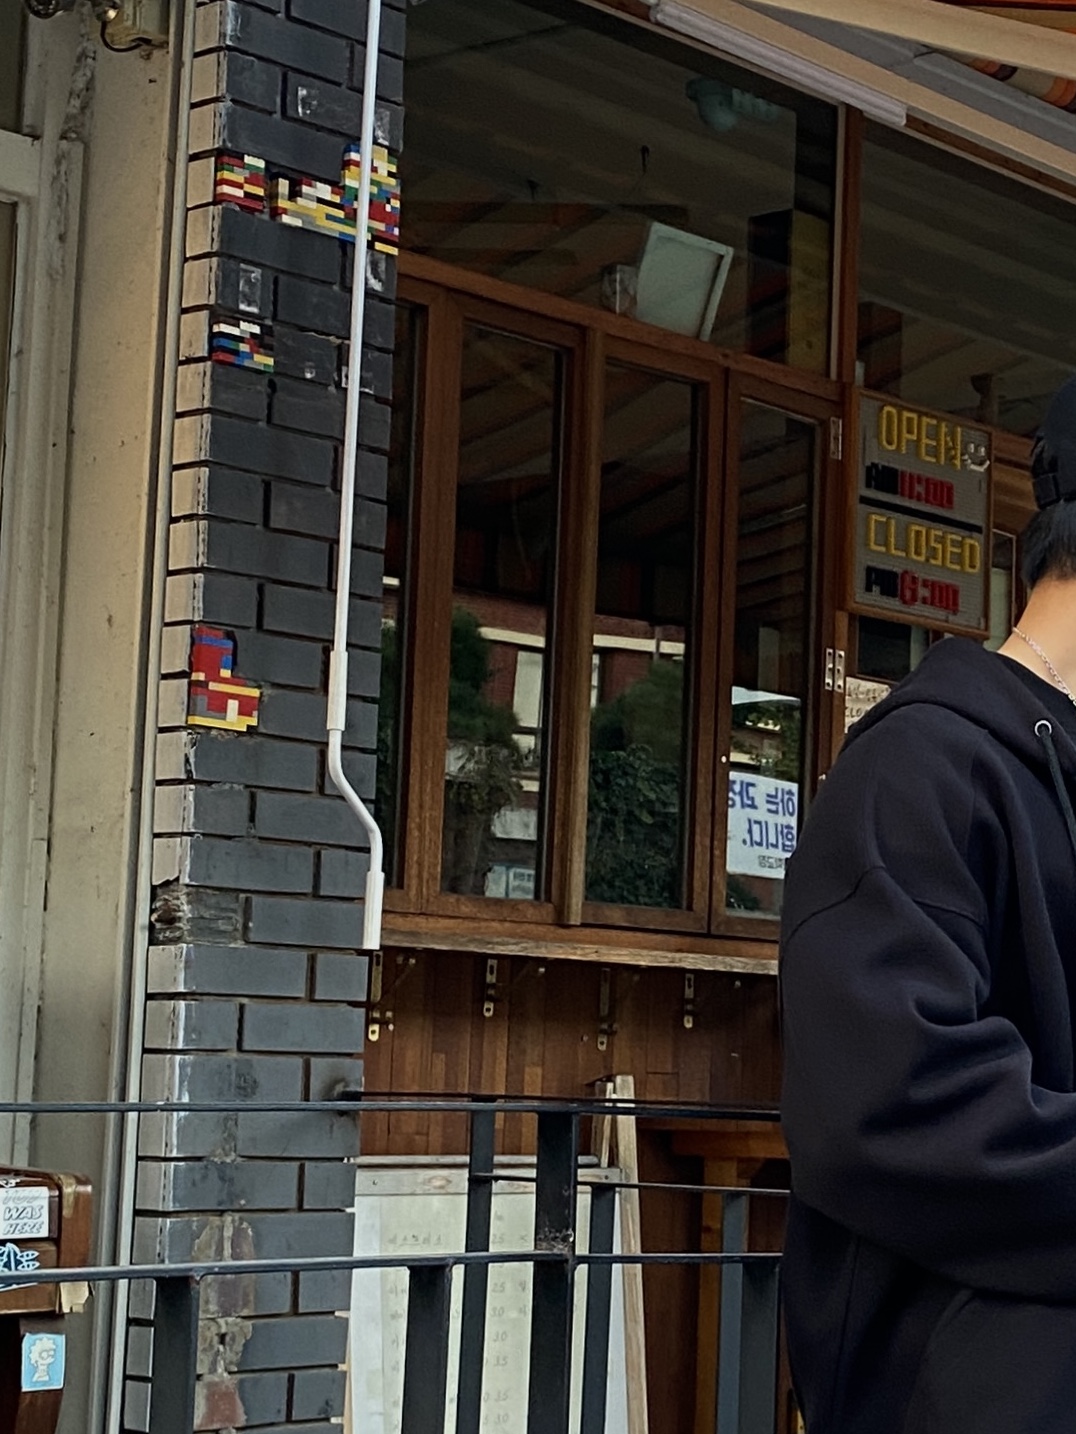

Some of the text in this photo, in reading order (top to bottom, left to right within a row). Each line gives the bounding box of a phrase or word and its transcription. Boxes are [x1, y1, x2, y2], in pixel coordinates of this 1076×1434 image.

[880, 404, 962, 470] OPEN
[868, 513, 980, 573] CLOSED
[2, 1220, 45, 1236] HERE
[3, 1204, 44, 1221] WAS
